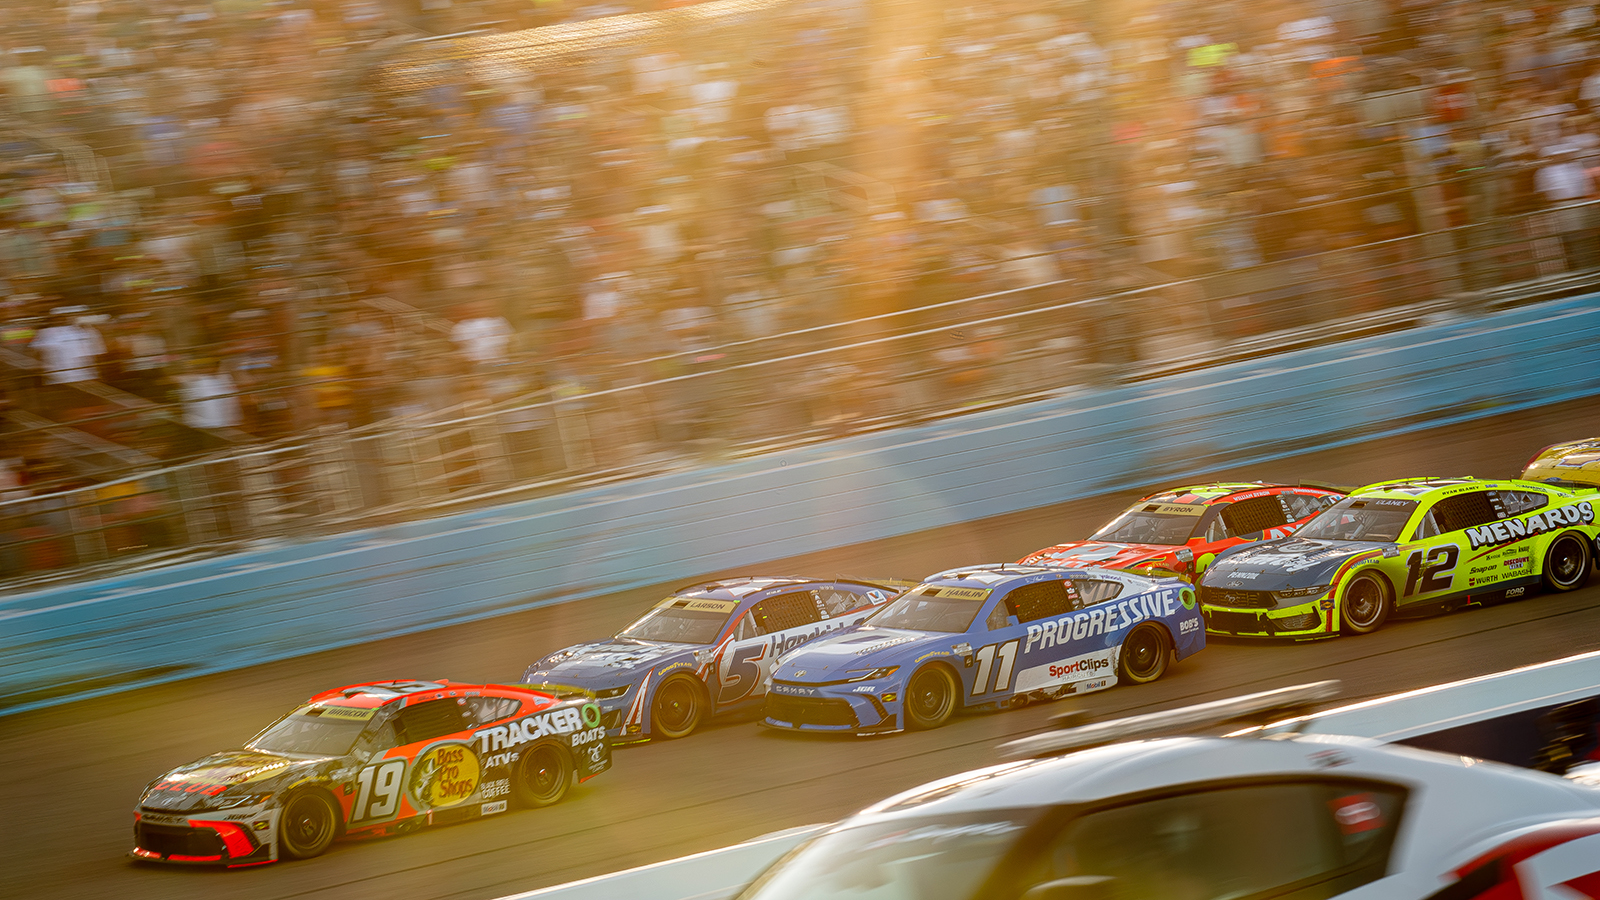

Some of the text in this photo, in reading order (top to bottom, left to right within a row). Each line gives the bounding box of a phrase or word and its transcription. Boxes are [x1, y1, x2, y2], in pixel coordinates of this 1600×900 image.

[1466, 502, 1594, 549] MENARDS
[1403, 543, 1460, 598] 12
[1503, 556, 1530, 566] DISCOUNT
[1501, 569, 1533, 579] WABASH
[944, 588, 985, 598] HAMLIN
[1505, 587, 1525, 596] FORD
[690, 601, 726, 610] LARSON
[1023, 589, 1176, 654] PROGRESSIVE
[1179, 617, 1199, 631] BOB'S
[717, 642, 768, 706] 5
[971, 639, 1019, 696] 11
[1049, 658, 1109, 678] SportClips
[1086, 681, 1100, 690] Mobil
[475, 706, 583, 754] TRACKER
[571, 725, 606, 747] BOATS
[437, 748, 464, 766] Bass
[484, 751, 520, 770] ATVs
[438, 764, 459, 781] Pro
[154, 780, 227, 796] CLUB
[352, 760, 405, 822] 19
[439, 778, 473, 798] Shops
